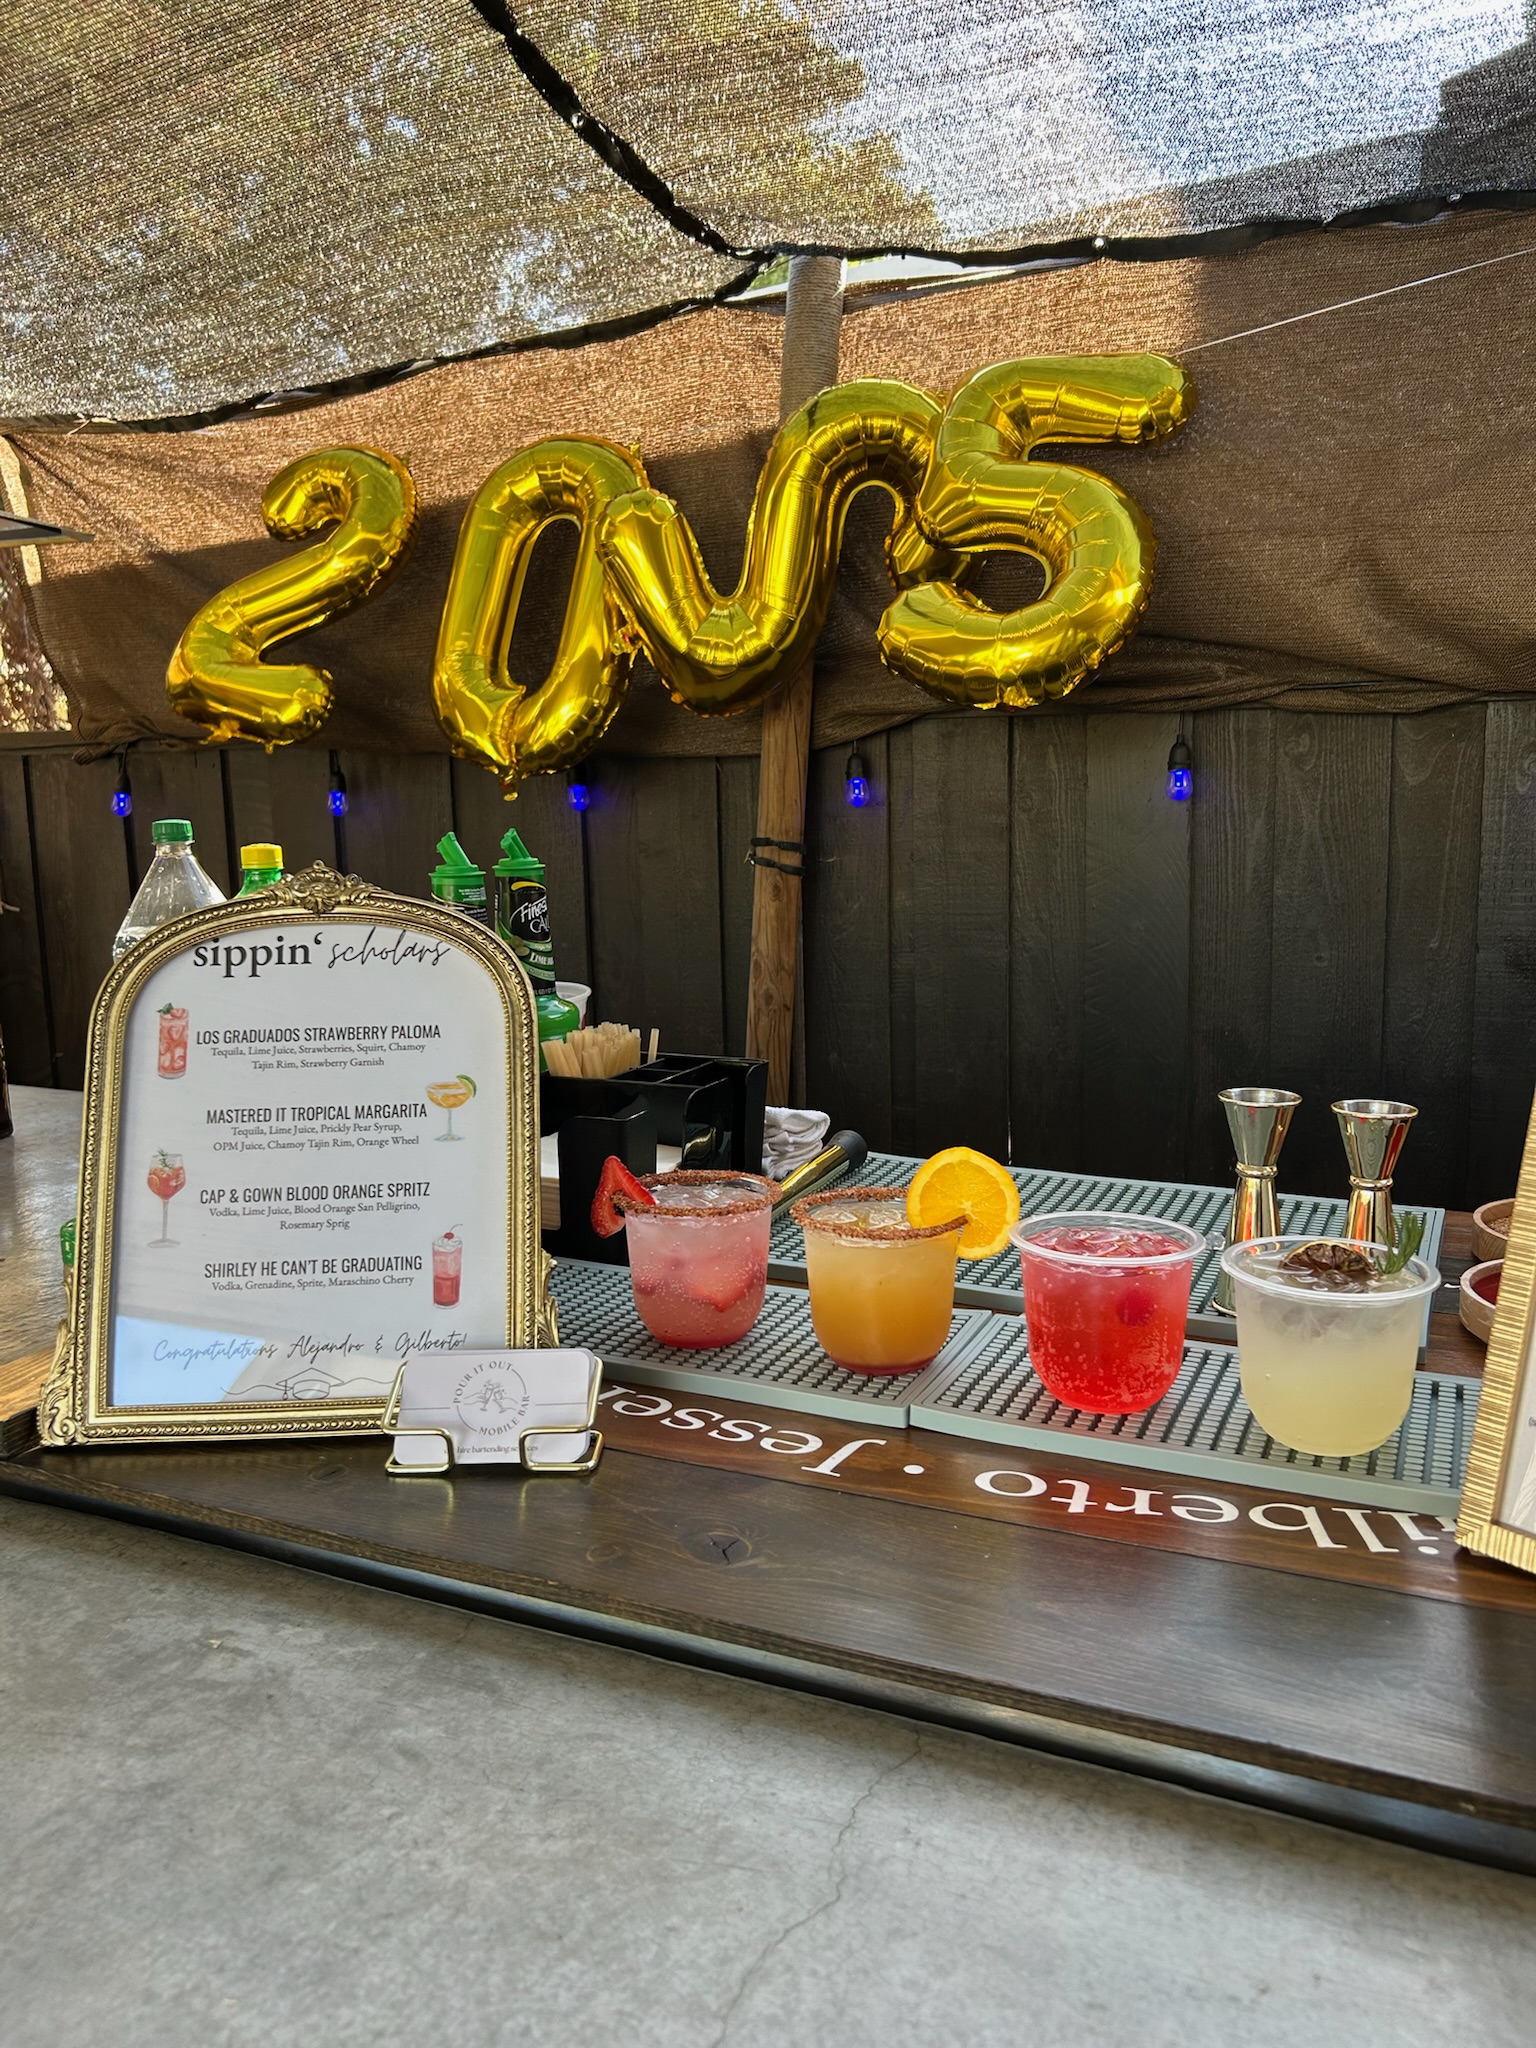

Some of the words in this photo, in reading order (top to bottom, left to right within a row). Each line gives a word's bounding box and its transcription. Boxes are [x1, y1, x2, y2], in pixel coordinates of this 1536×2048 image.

[327, 926, 451, 968] scholars
[196, 1030, 220, 1045] LOS
[223, 1027, 300, 1044] GRADUADOS
[304, 1025, 388, 1042] STRAWBERRY
[391, 1024, 441, 1040] PALOMA
[211, 1047, 246, 1059] Tequila,
[248, 1046, 271, 1055] Lime
[271, 1045, 297, 1057] Juice,
[299, 1044, 355, 1054] Strawberries,
[357, 1043, 387, 1055] Squirt,
[388, 1042, 426, 1053] Chamoy
[252, 1060, 274, 1072] Tajin
[276, 1060, 299, 1069] Rim,
[300, 1058, 348, 1070] Strawberry
[350, 1057, 385, 1067] Garnish
[206, 1108, 272, 1124] MASTERED
[276, 1107, 287, 1122] IT
[291, 1105, 351, 1121] TROPICAL
[355, 1103, 427, 1119] MARGARITA
[231, 1126, 267, 1138] Tequila,
[269, 1125, 292, 1135] Lime
[292, 1125, 319, 1136] Juice,
[320, 1123, 351, 1135] Prickly
[353, 1123, 372, 1132] Pear
[373, 1122, 402, 1134] Syrup,
[213, 1142, 238, 1151] OPM
[239, 1141, 265, 1153] Juice,
[267, 1140, 306, 1151] Chamoy
[307, 1139, 330, 1151] Tajin
[332, 1138, 355, 1148] Rim,
[356, 1137, 390, 1149] Orange
[391, 1135, 419, 1145] Wheel
[200, 1189, 226, 1204] CAP
[230, 1188, 239, 1203] &
[243, 1187, 282, 1203] GOWN
[286, 1185, 329, 1201] BLOOD
[333, 1183, 384, 1200] ORANGE
[387, 1181, 431, 1198] SPRITZ
[209, 1207, 240, 1217] Vodka,
[242, 1206, 266, 1216] Lime
[267, 1206, 292, 1217] Juice,
[294, 1204, 321, 1214] Blood
[323, 1203, 356, 1215] Orange
[358, 1203, 374, 1212] San
[376, 1201, 421, 1214] Pelligrino,
[280, 1219, 325, 1231] Rosemary
[326, 1218, 350, 1230] Sprig
[204, 1262, 257, 1279] SHIRLEY
[261, 1261, 278, 1277] HE
[281, 1259, 319, 1276] CAN’T
[322, 1258, 338, 1274] BE
[342, 1255, 423, 1273] GRADUATING
[212, 1281, 243, 1292] Vodka,
[245, 1279, 295, 1291] Grenadine,
[297, 1278, 326, 1290] Sprite,
[328, 1276, 381, 1287] Maraschino
[382, 1275, 415, 1287] Cherry
[153, 1337, 279, 1371] Congratulations
[287, 1333, 365, 1365] Alejandro
[394, 1328, 467, 1361] Gilberto!
[453, 1373, 473, 1404] POUR
[473, 1363, 484, 1375] IT
[489, 1360, 512, 1371] OUT
[480, 1417, 520, 1436] MOBILE
[517, 1395, 531, 1416] BAR
[457, 1446, 471, 1454] hire
[471, 1445, 510, 1454] bartending
[974, 1470, 1456, 1555] ilberto
